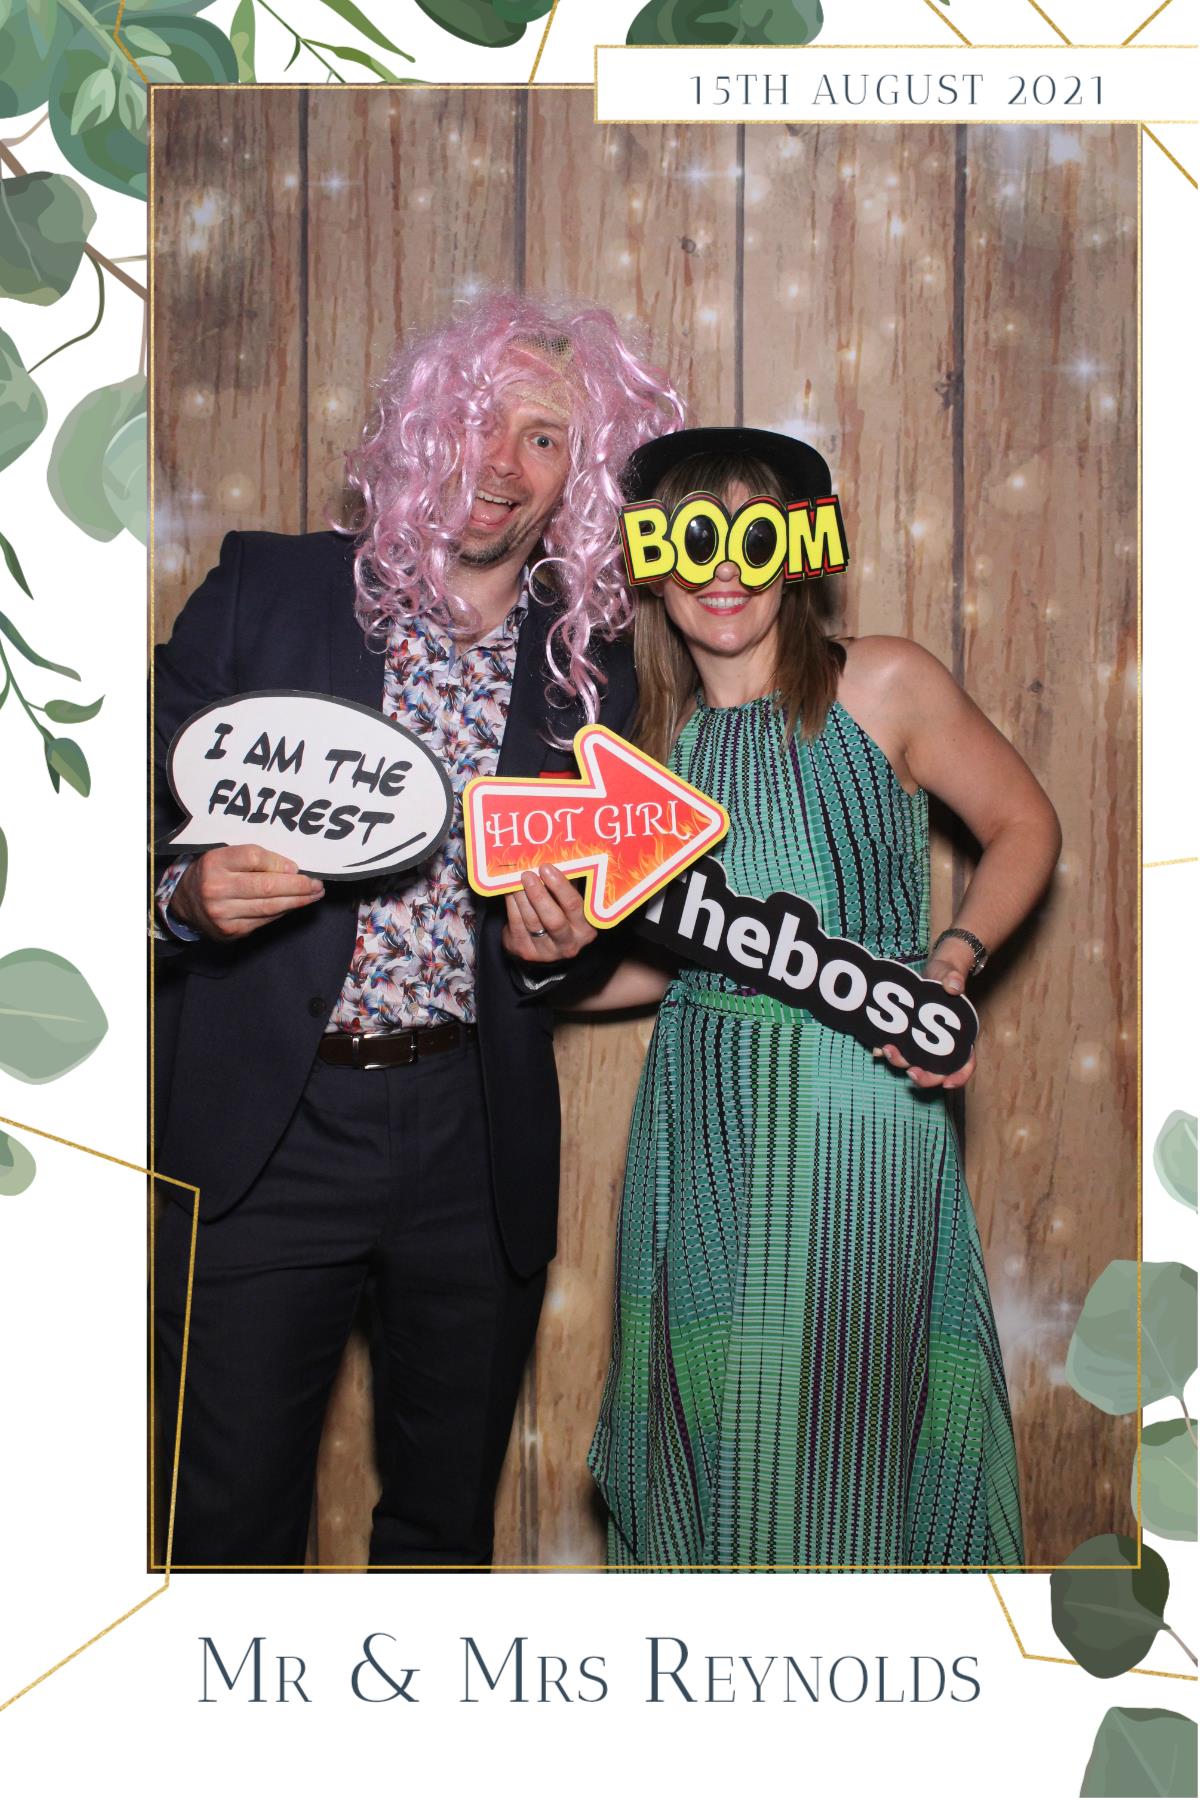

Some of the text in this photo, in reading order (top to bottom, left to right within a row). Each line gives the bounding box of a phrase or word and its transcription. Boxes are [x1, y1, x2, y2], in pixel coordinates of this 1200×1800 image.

[621, 496, 847, 589] BOOM
[204, 722, 413, 797] I AM THE
[208, 778, 395, 847] FAIREST
[486, 799, 693, 848] HOT GIRL
